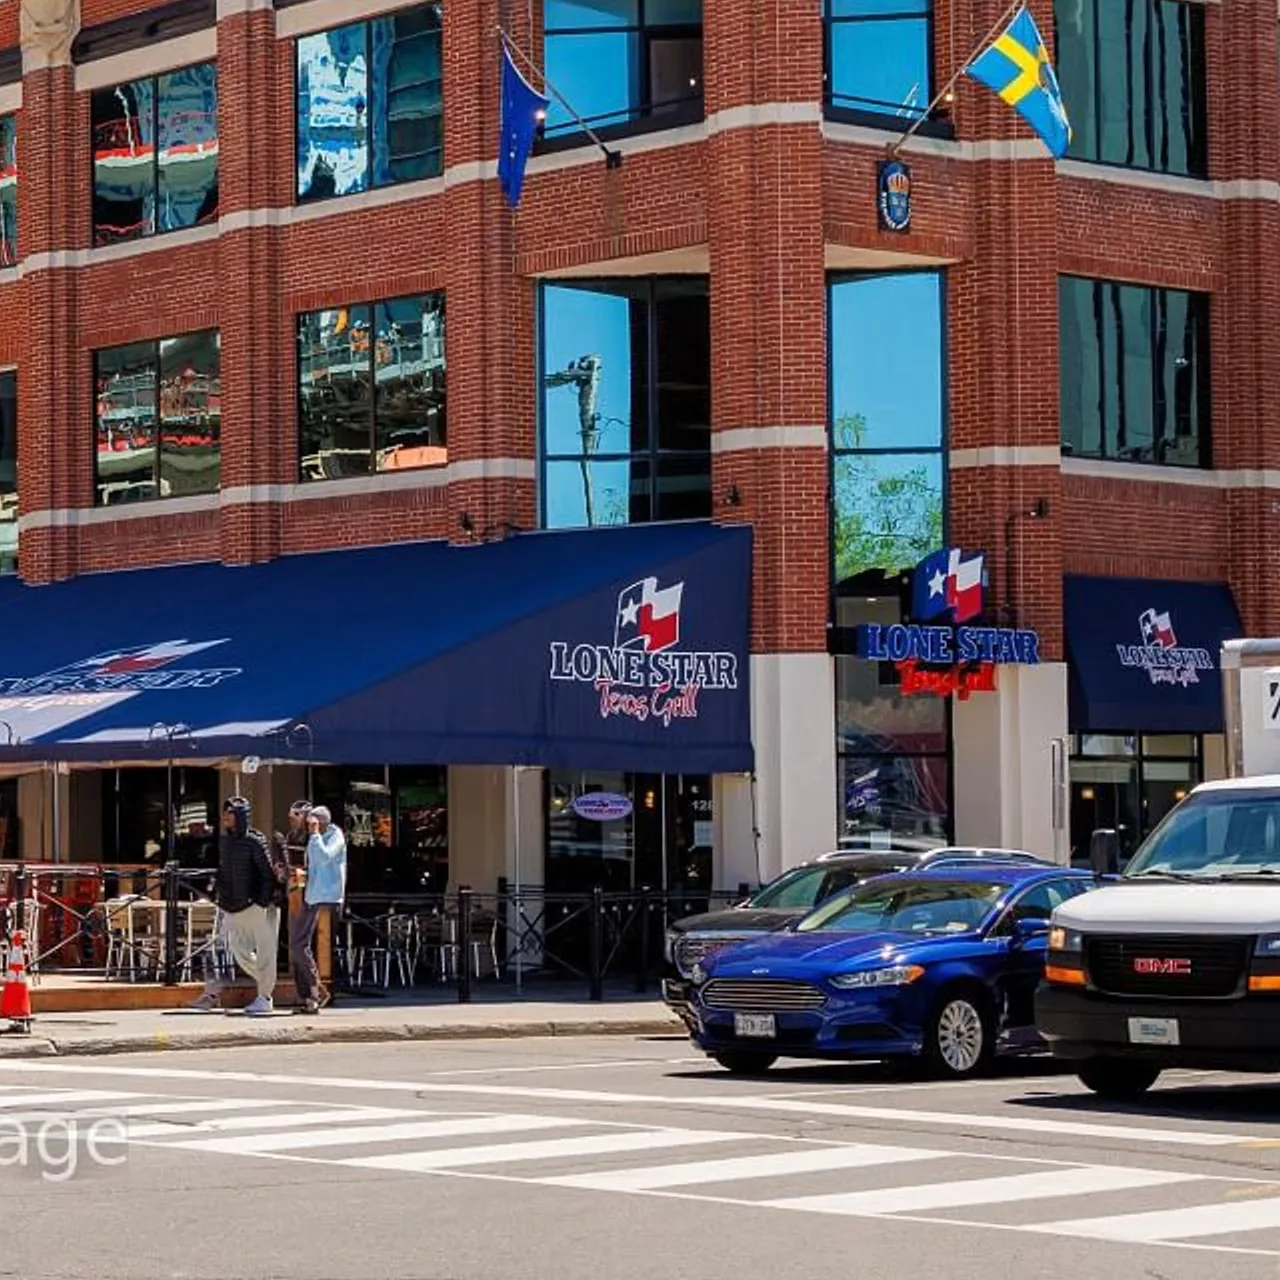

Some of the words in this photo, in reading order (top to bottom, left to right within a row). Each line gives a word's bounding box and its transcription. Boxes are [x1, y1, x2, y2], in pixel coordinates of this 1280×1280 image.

[867, 624, 953, 662] LONE
[957, 626, 1040, 663] STAR
[1116, 644, 1168, 668] LONE
[1164, 648, 1215, 669] STAR
[550, 642, 644, 687] LONE
[649, 651, 738, 689] STAR
[594, 678, 649, 721] Texas
[649, 683, 700, 727] Grill
[1135, 958, 1191, 973] GMC
